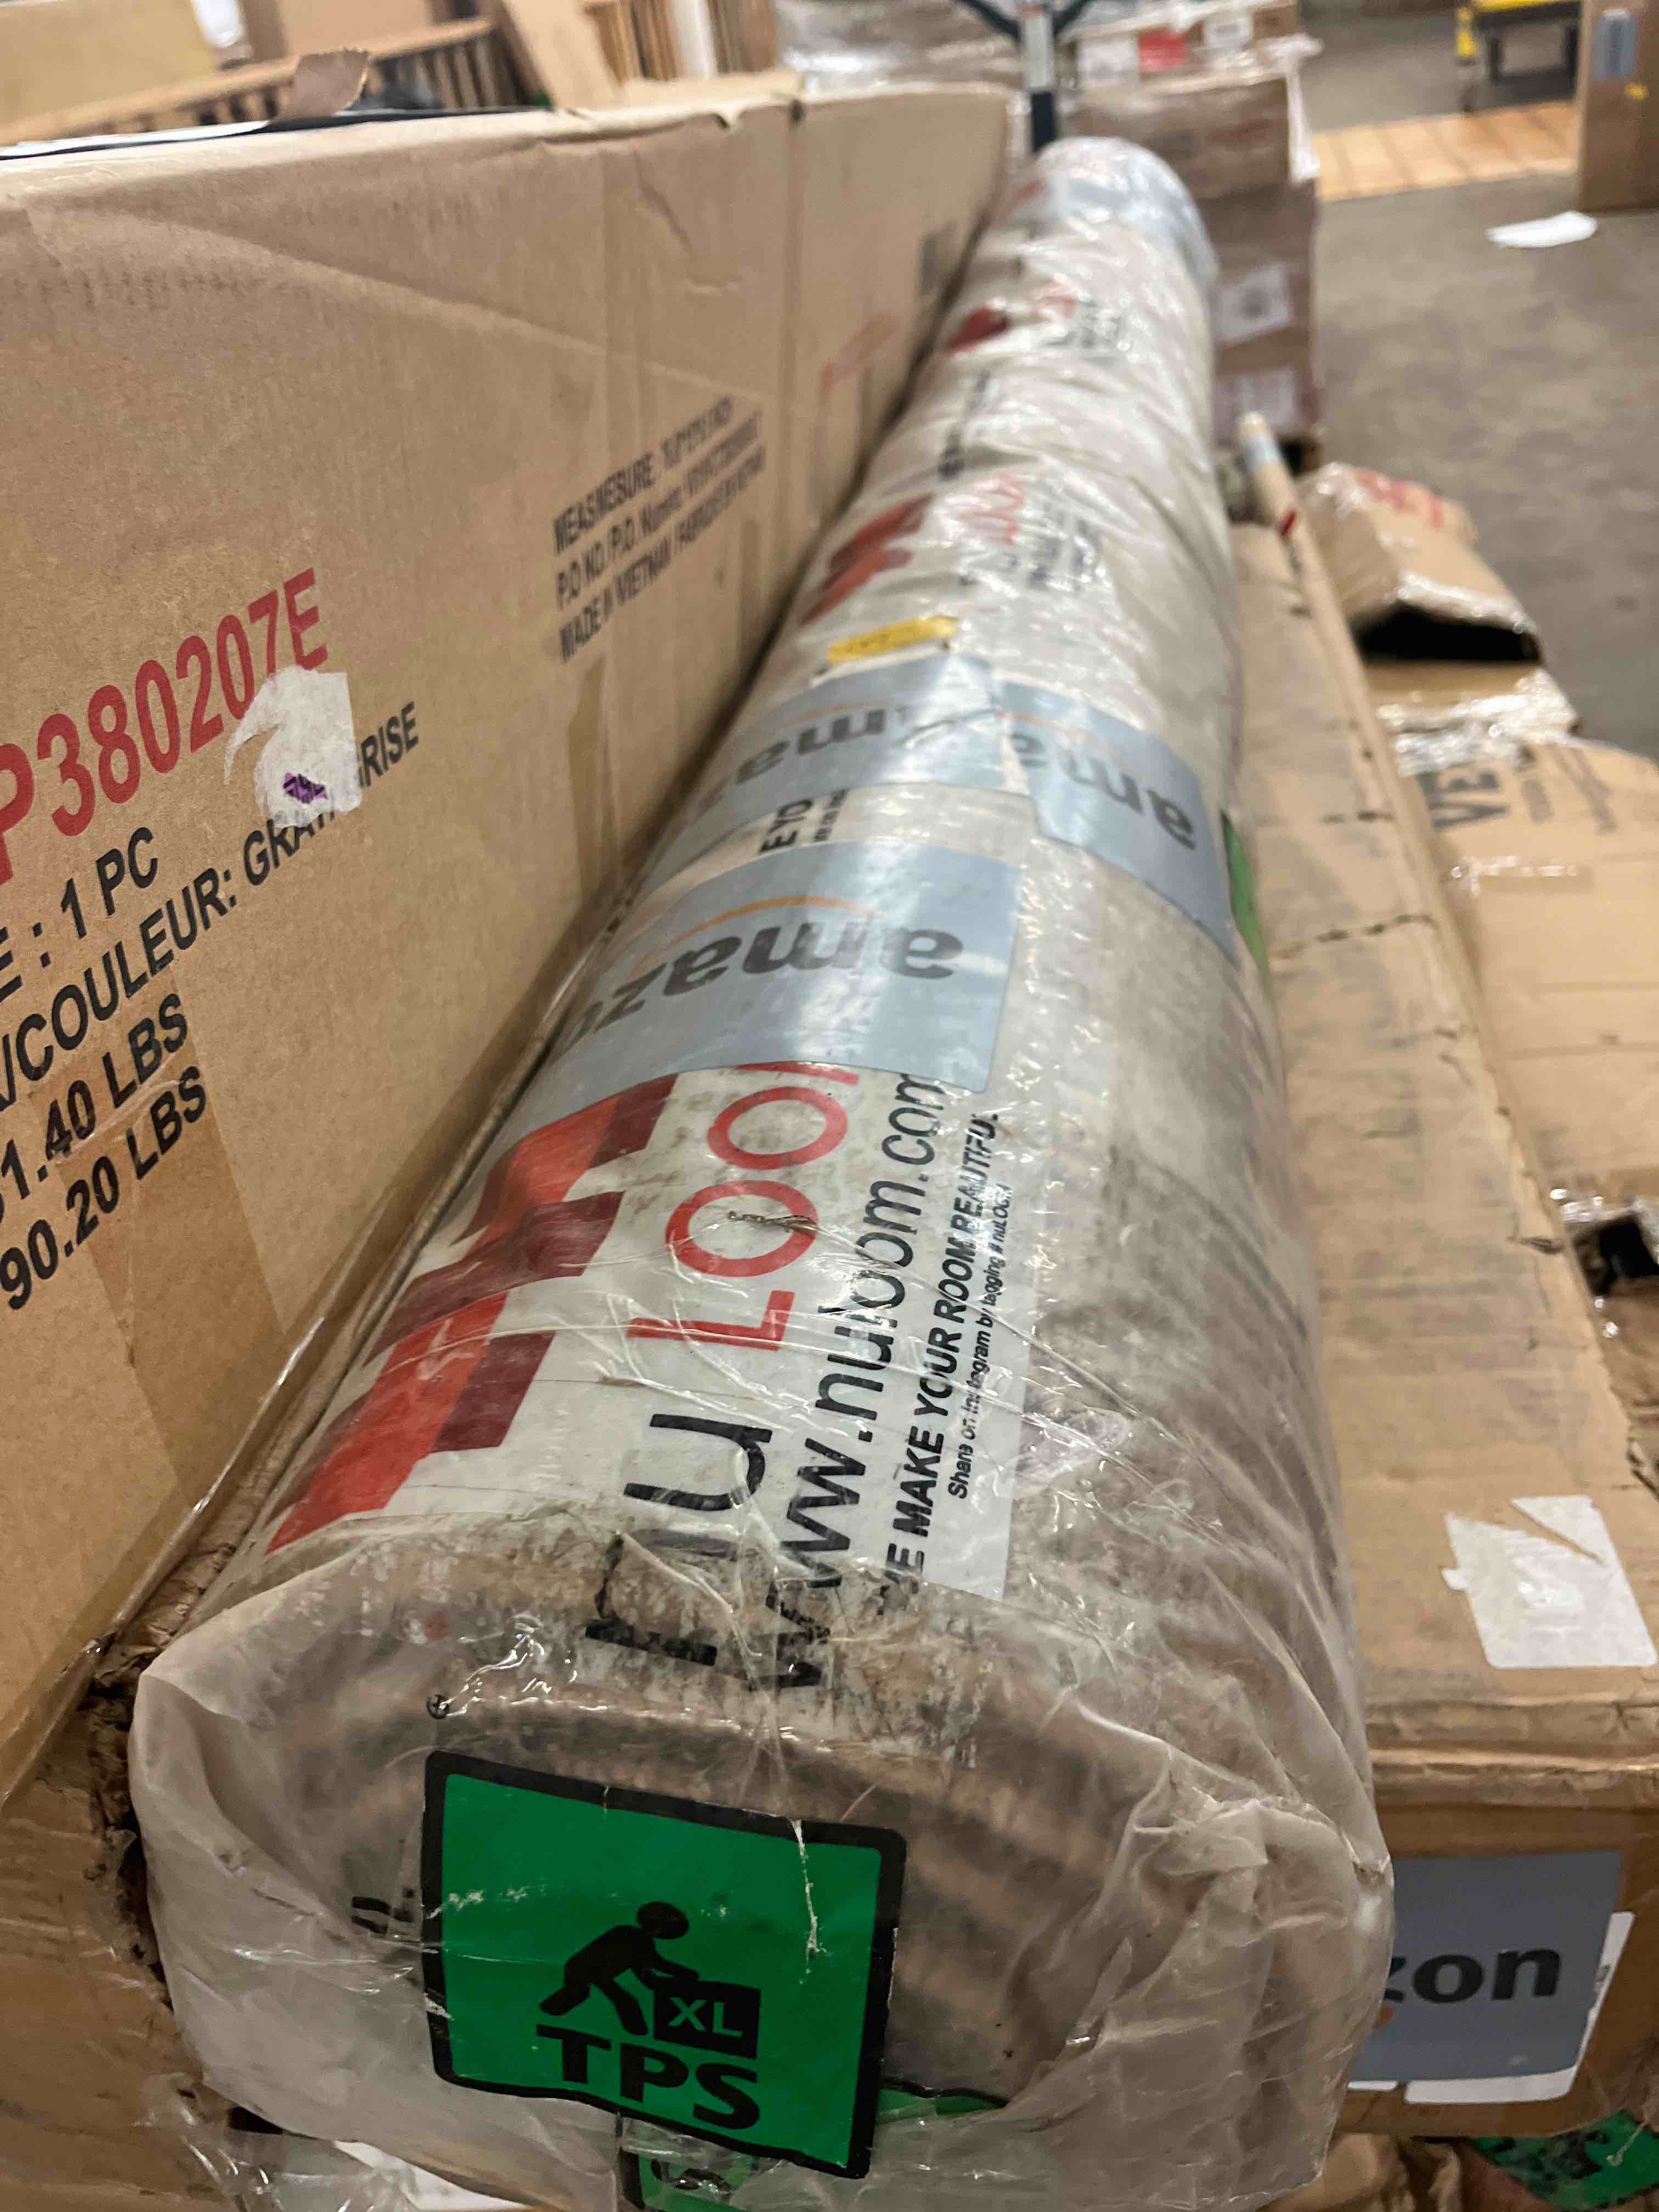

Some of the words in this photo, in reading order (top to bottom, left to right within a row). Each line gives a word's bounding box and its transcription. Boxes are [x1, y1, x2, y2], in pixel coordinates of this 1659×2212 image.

[61, 877, 87, 939] 1
[95, 826, 159, 916] PC
[0, 1079, 96, 1223] 1.40
[102, 993, 188, 1109] LBS
[0, 1156, 120, 1310] 90.20
[126, 1065, 206, 1181] LBS
[933, 1236, 977, 1324] ROOM
[913, 1327, 963, 1417] YOUR
[947, 1443, 974, 1499] Share
[979, 1256, 1006, 1306] tagging
[893, 1425, 945, 1537] MAKE
[668, 1996, 743, 2038] XL
[535, 2023, 760, 2130] TPS
